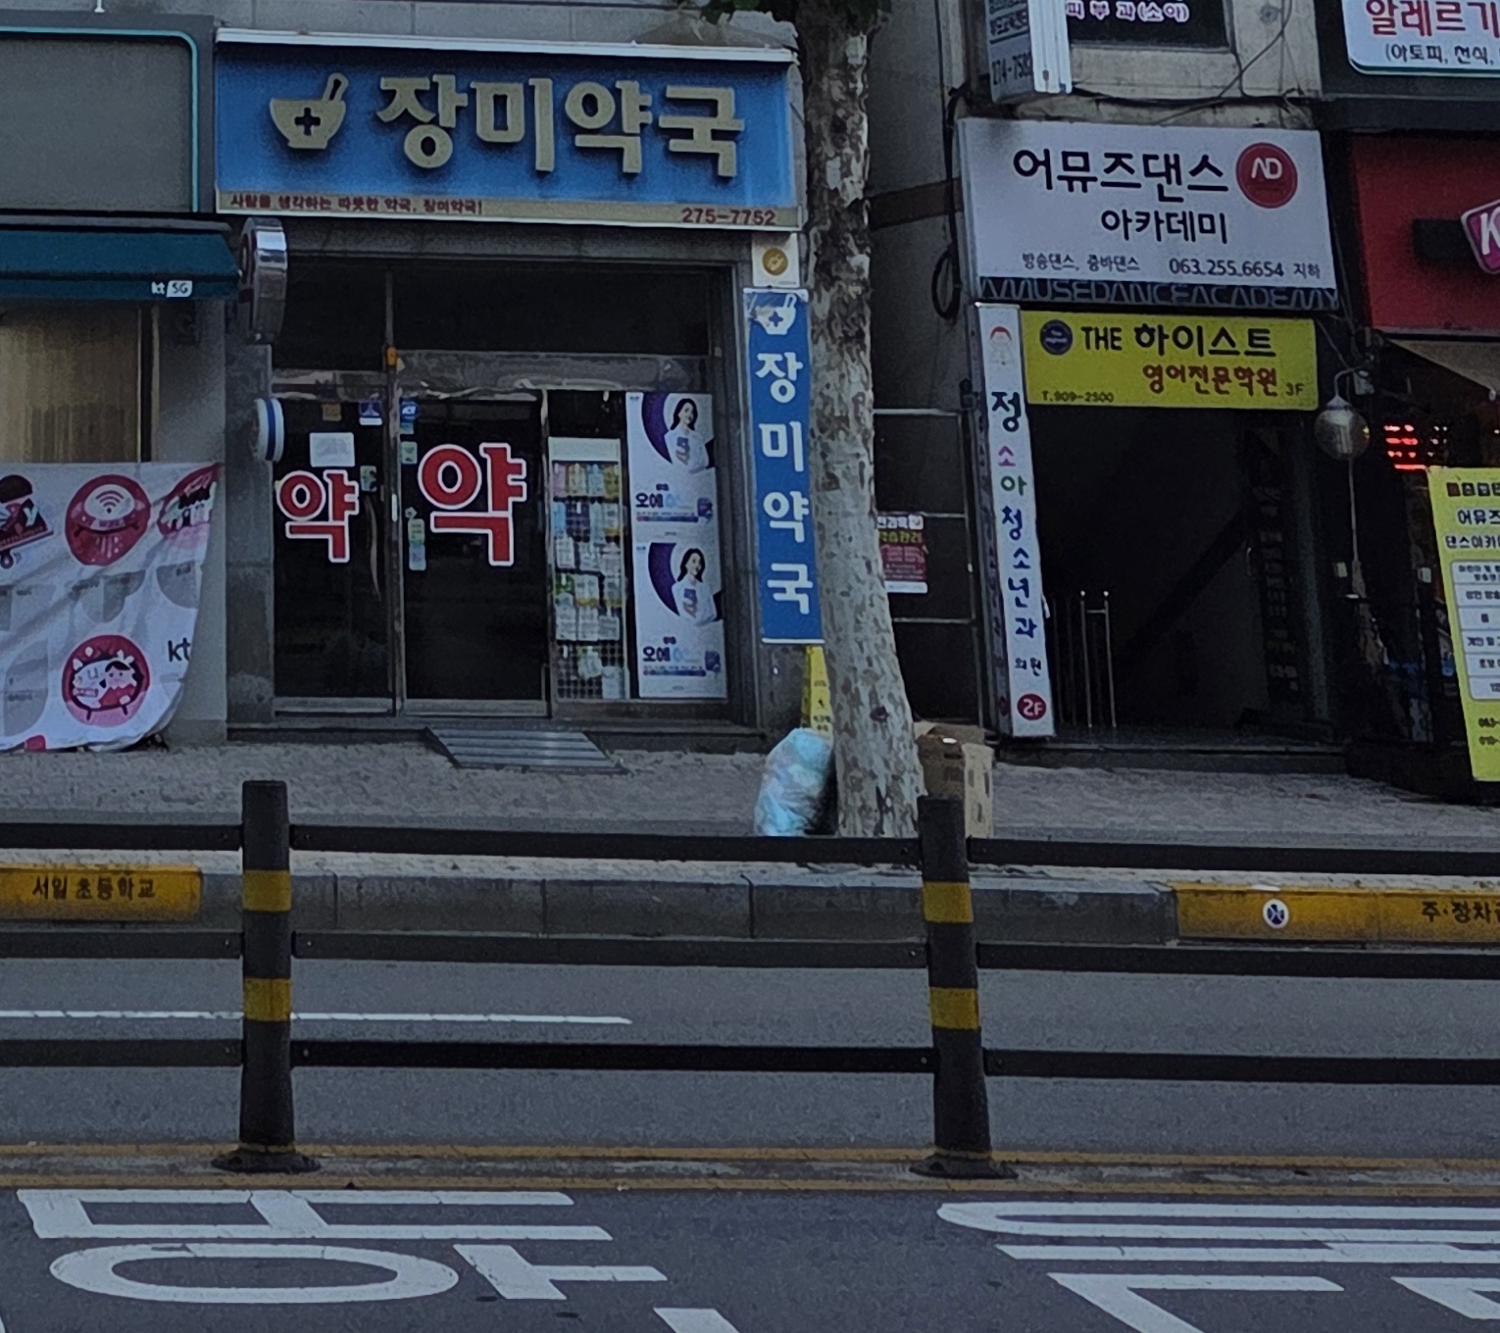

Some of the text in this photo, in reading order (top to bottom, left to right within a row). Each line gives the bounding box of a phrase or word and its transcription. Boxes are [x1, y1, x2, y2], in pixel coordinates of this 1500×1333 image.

[376, 73, 746, 179] 장미약국
[1012, 147, 1230, 204] 어뮤즈댄스
[681, 207, 777, 227] 275-7752
[1101, 209, 1229, 244] 아카데미
[1293, 260, 1321, 279] 지하
[1080, 323, 1277, 357] THE 하이스트
[1142, 364, 1278, 398] 영어전문학원
[991, 391, 1023, 433] 정
[756, 351, 814, 616] 장미약국
[277, 442, 527, 567] 약 약
[167, 637, 192, 664] kt
[1019, 696, 1045, 718] 2F
[74, 875, 156, 901] 초등학교
